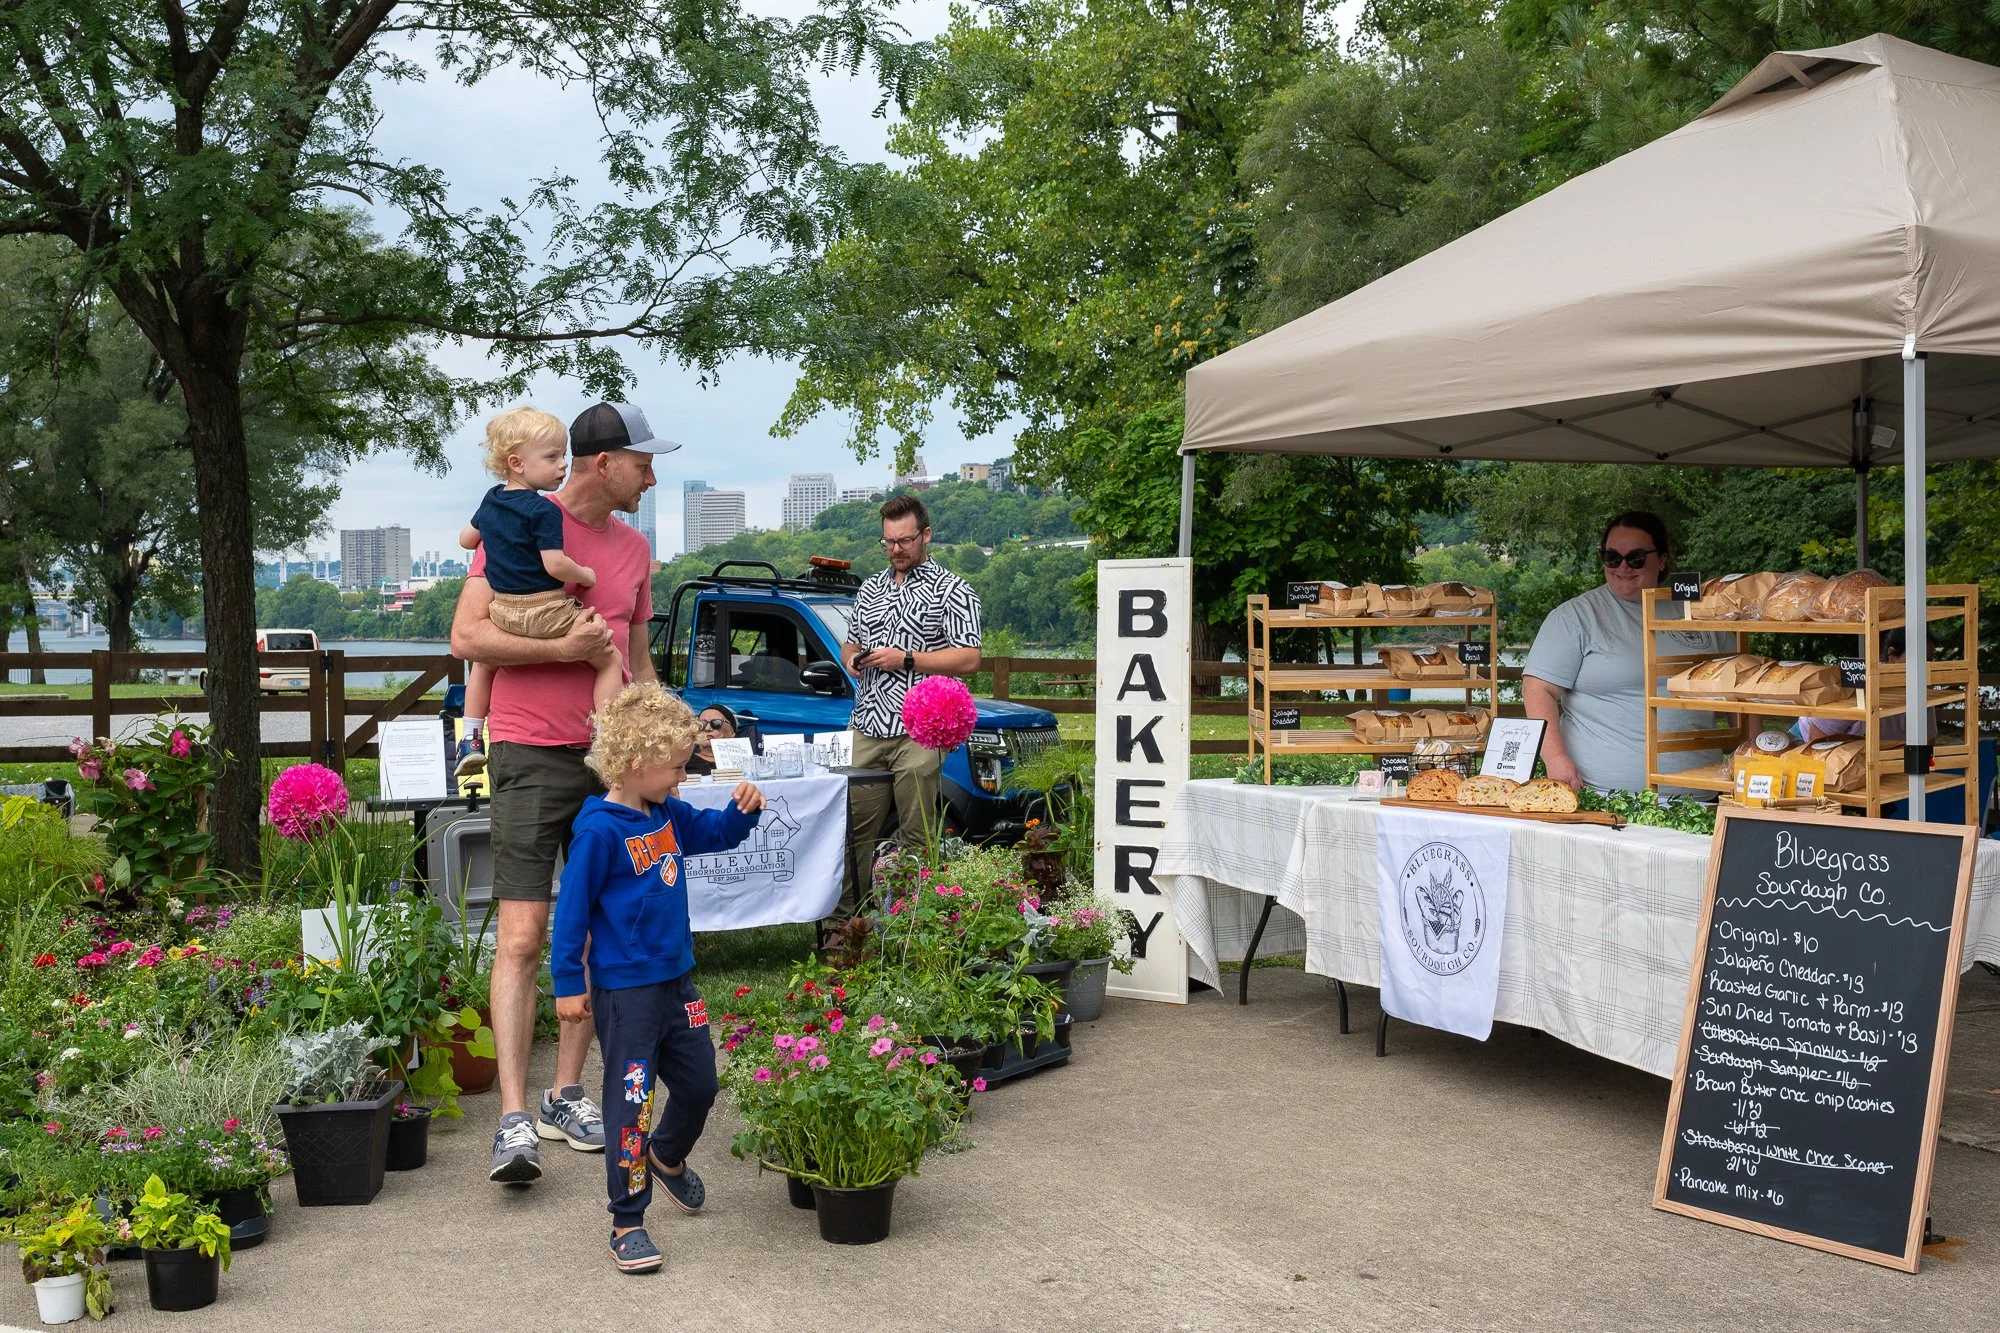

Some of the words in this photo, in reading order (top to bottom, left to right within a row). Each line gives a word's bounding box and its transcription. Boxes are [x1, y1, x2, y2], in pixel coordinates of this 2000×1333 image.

[1674, 582, 1698, 597] Original
[1464, 643, 1484, 651] Tomato
[1846, 671, 1866, 684] Sprin
[1114, 588, 1168, 960] BAKERY
[684, 851, 786, 870] ELLEVUE
[686, 867, 732, 877] HBORHOOD
[734, 862, 786, 873] ASSOCIATION
[1409, 847, 1472, 881] BLUEGRASS
[1774, 830, 1890, 882] Bluegrass
[1755, 871, 1848, 910] Sourdough
[1859, 881, 1892, 906] Co.
[1407, 929, 1462, 972] SOURDOUGH
[1462, 940, 1478, 959] CO.
[1793, 931, 1819, 954] $10
[1714, 946, 1775, 976] Jalapeño
[1842, 973, 1864, 994] $13
[1709, 969, 1762, 997] Roasted
[1764, 983, 1810, 1007] Garlic
[1832, 994, 1871, 1019] Parm
[1881, 1001, 1904, 1023] $13
[1701, 1020, 1781, 1052] Celebration
[1705, 997, 1732, 1017] Sun
[1735, 1002, 1773, 1024] Dried
[1779, 1011, 1831, 1034] Tomato
[1897, 1030, 1918, 1054] $13
[1695, 1069, 1736, 1092] Brown
[1740, 1077, 1777, 1098] Butter
[1779, 1086, 1810, 1103] Choc
[1846, 1094, 1896, 1114] Cookies
[1684, 1128, 1761, 1165] Strawberry
[1765, 1144, 1801, 1162] White
[1844, 1153, 1886, 1175] Scones
[1679, 1166, 1729, 1194] Pancake
[1766, 1189, 1784, 1206] $6
